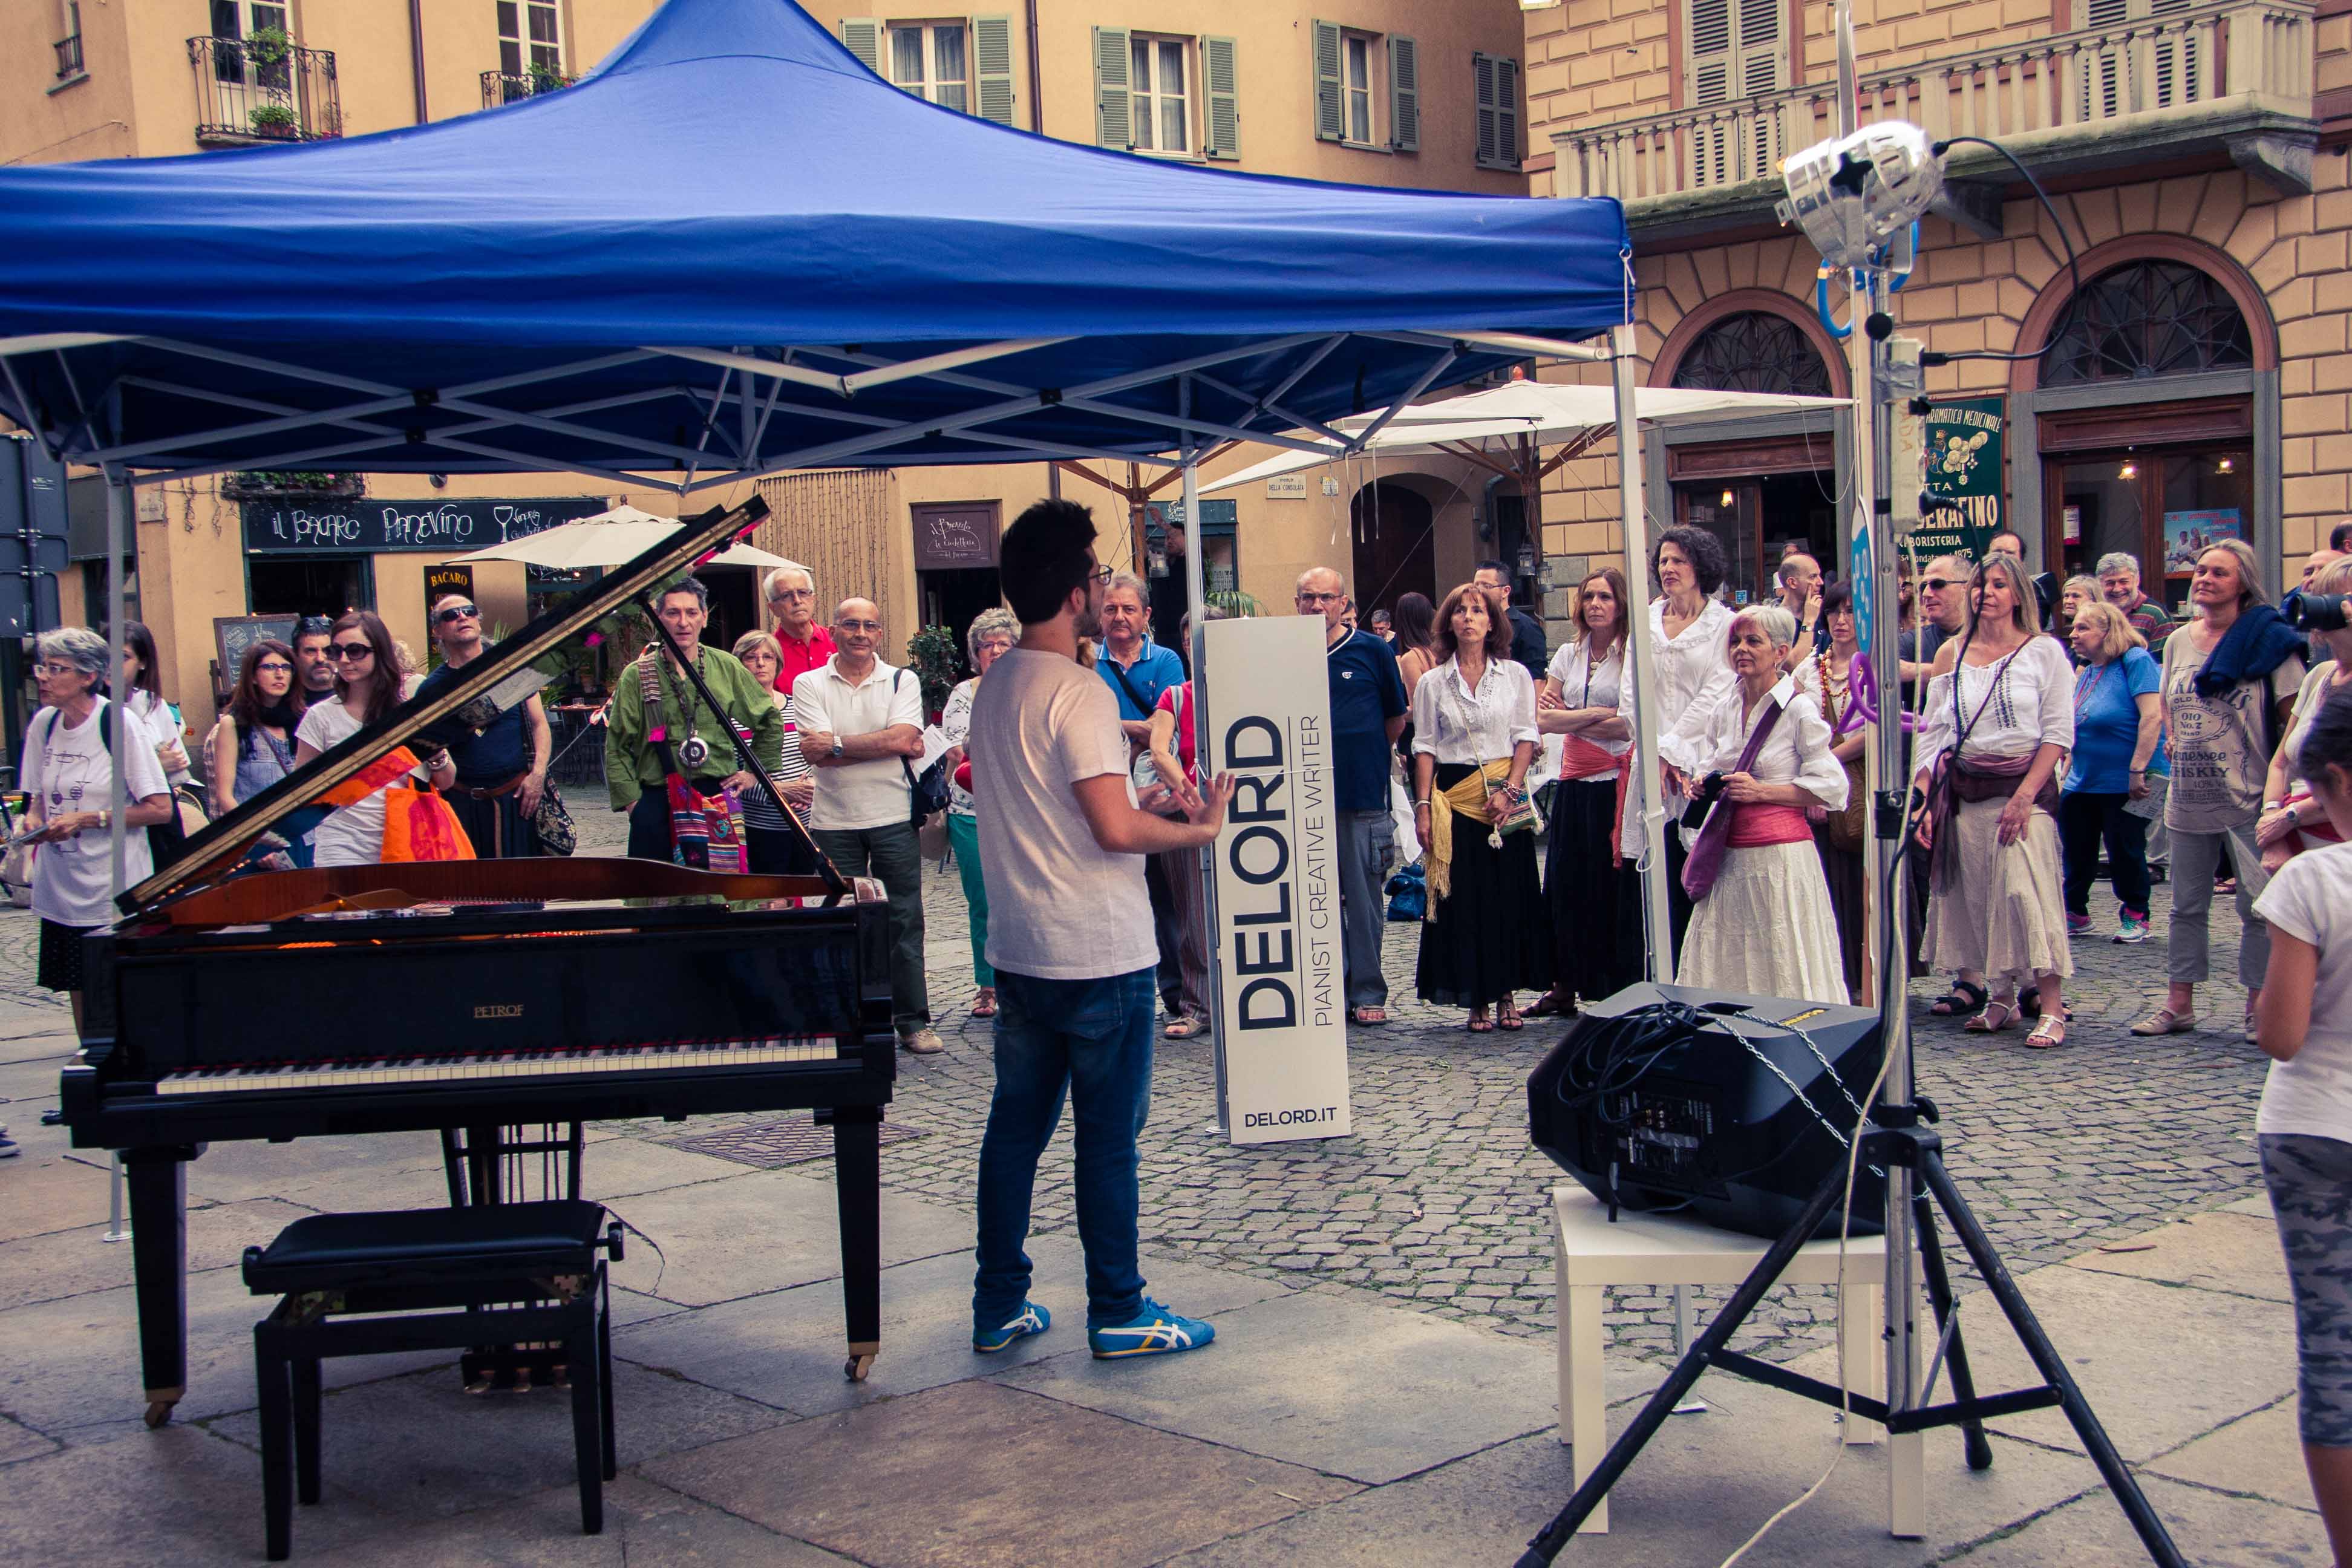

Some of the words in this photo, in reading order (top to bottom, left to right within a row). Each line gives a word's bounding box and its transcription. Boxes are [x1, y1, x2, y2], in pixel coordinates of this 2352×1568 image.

[1926, 408, 1962, 424] AROMATICA
[1963, 410, 2002, 433] MEDICINALE
[431, 572, 468, 587] BACARO
[1301, 716, 1322, 809] WRITER
[1225, 716, 1296, 1031] DELORD
[1305, 815, 1328, 929] CREATIVE
[1311, 937, 1333, 1027] PIANIST
[474, 1004, 524, 1019] PETROF
[1244, 1106, 1338, 1128] DELORD.IT
